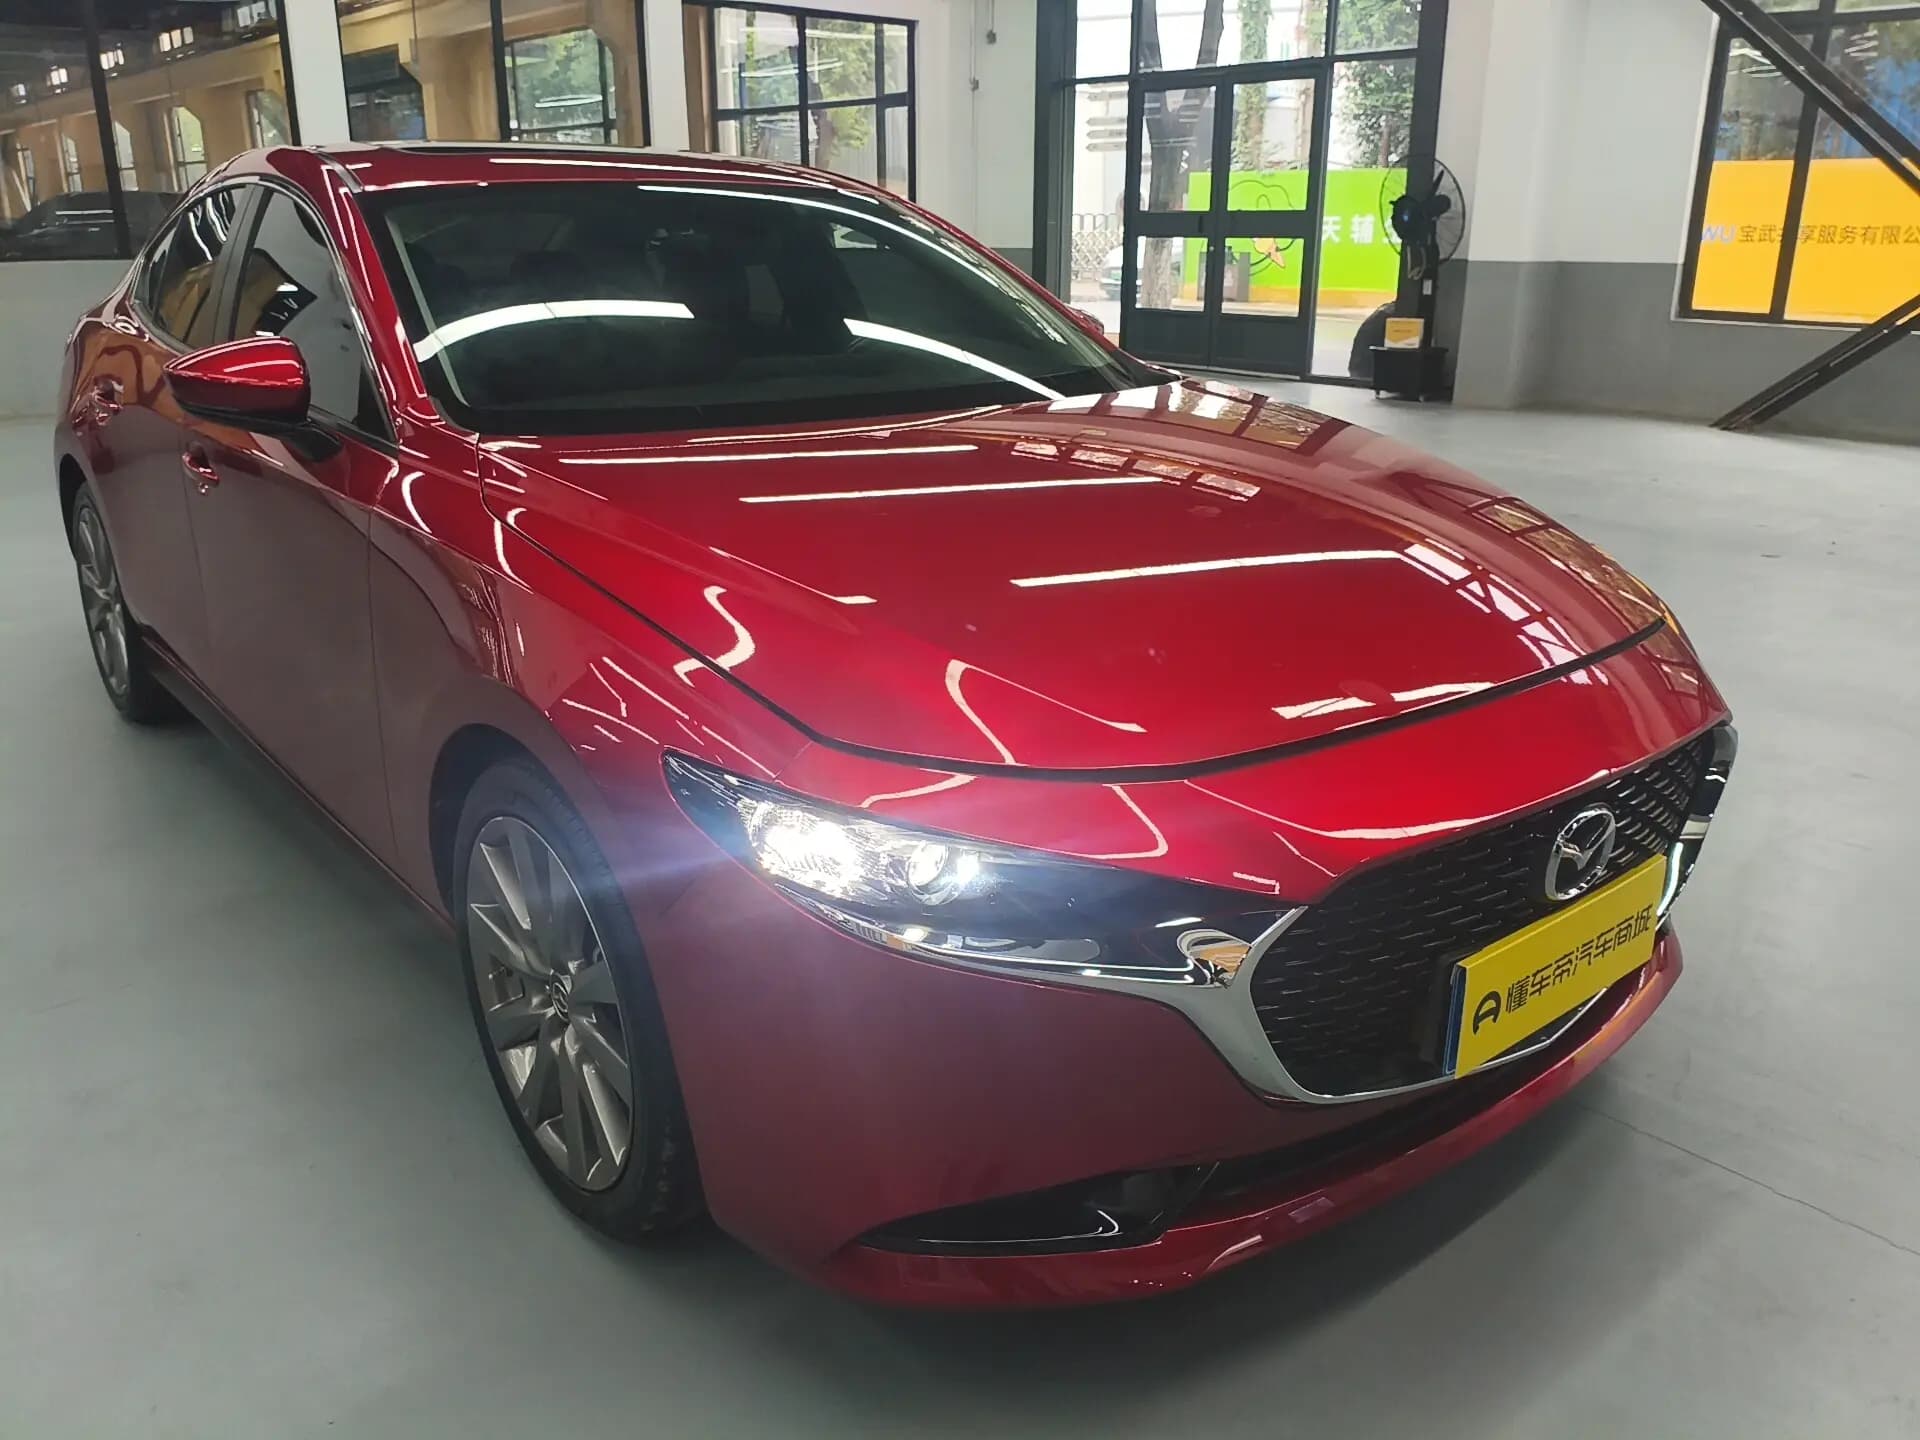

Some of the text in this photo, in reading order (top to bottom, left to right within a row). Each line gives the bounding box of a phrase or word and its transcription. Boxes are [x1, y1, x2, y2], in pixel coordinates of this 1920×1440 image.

[1505, 904, 1653, 1014] 懂车帝汽车商城
